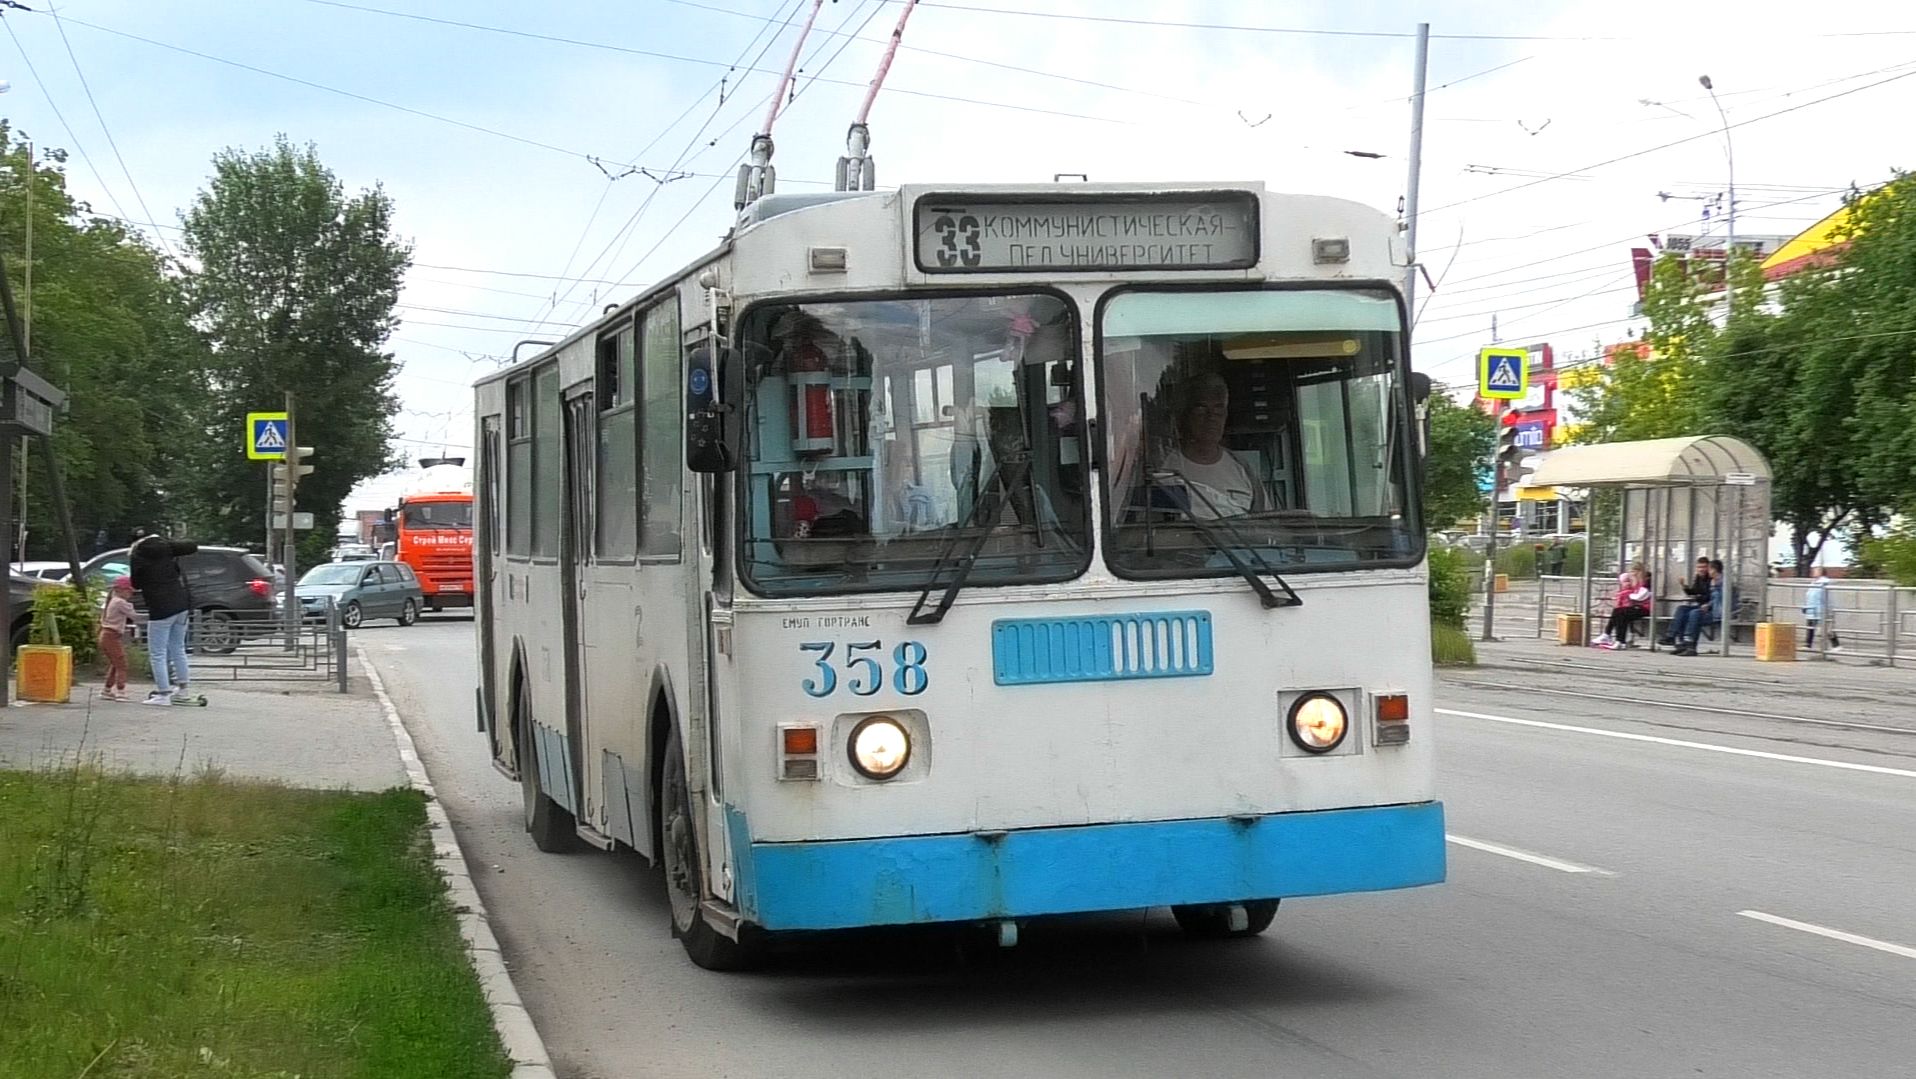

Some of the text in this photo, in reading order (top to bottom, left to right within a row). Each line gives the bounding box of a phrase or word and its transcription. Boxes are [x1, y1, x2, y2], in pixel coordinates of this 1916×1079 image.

[934, 215, 982, 268] 33
[782, 615, 872, 629] ЕМУП ГОРТРАНС
[799, 639, 929, 698] 358
